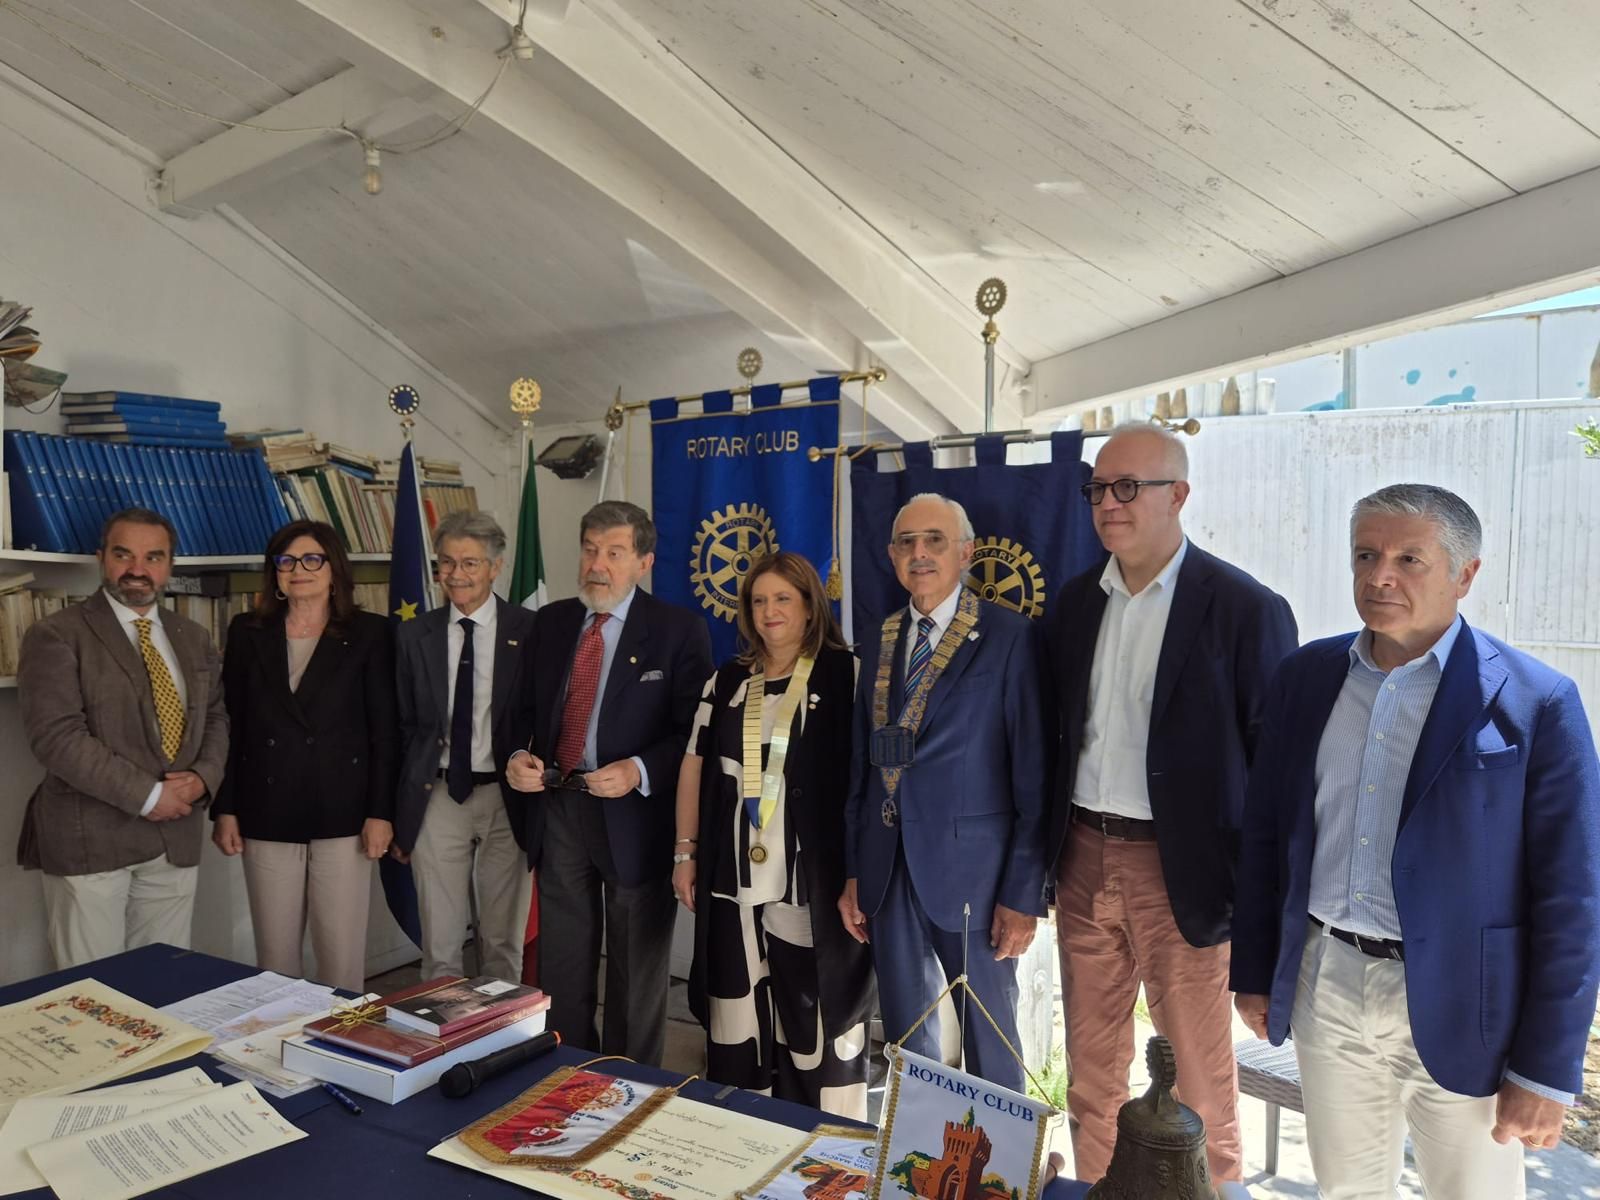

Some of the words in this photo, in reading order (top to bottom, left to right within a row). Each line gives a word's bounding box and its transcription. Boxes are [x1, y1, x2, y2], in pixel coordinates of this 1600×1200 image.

[687, 436, 752, 459] ROTARY
[755, 430, 799, 455] CLUB
[725, 518, 760, 529] ROTARY
[908, 1063, 980, 1101] ROTARY
[983, 1093, 1034, 1122] CLUB
